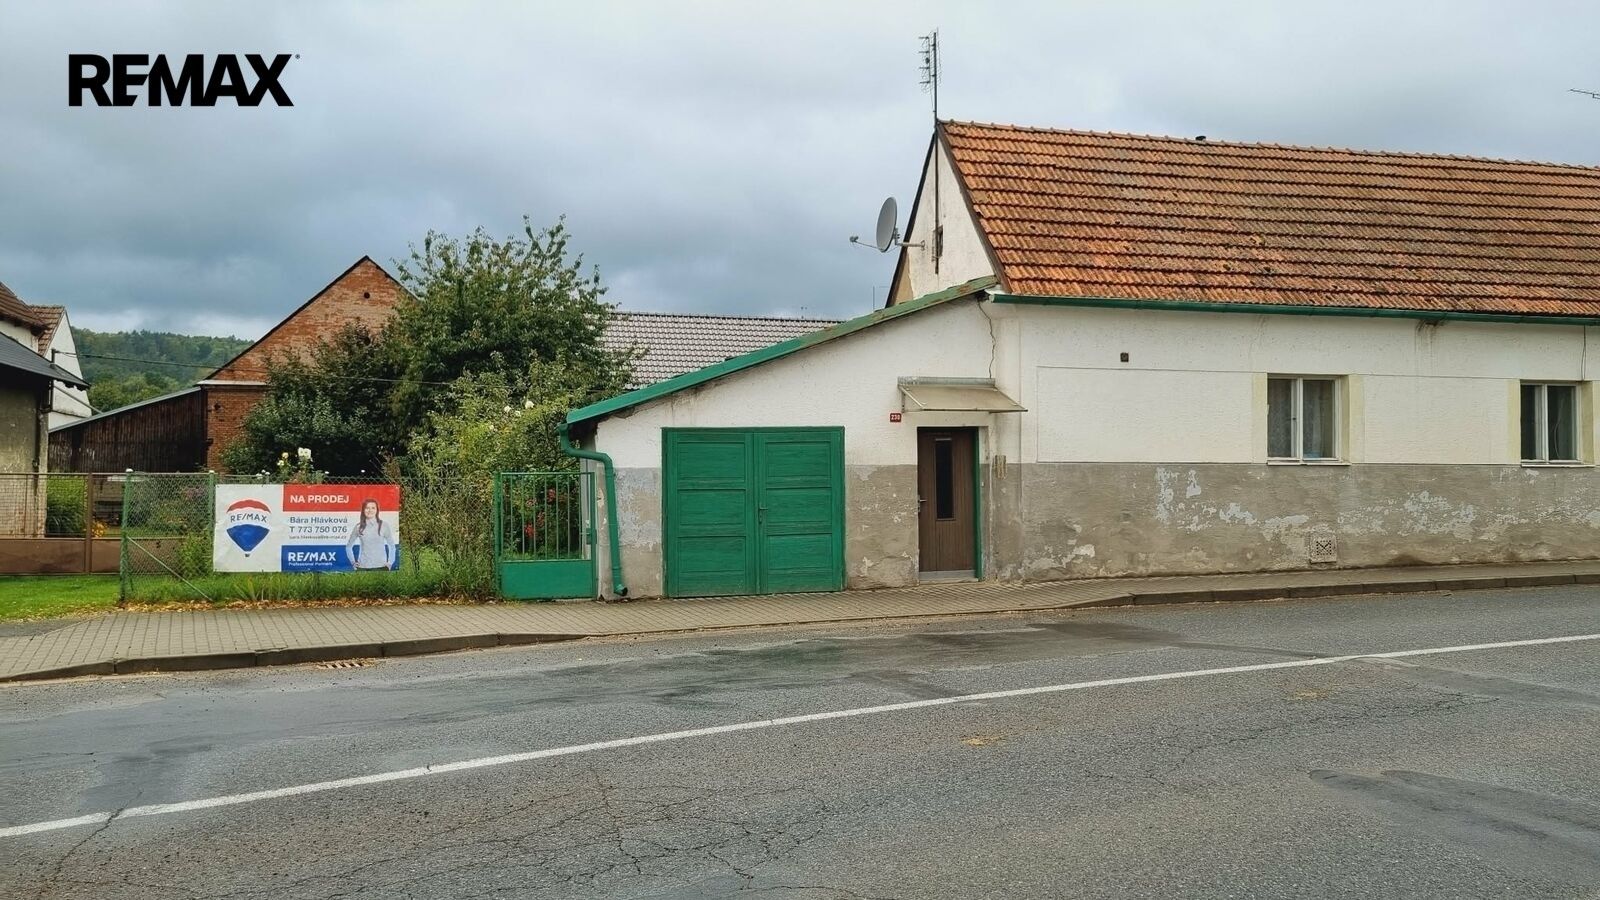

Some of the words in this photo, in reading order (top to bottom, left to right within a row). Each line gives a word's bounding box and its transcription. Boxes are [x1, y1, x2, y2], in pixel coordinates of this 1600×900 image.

[290, 494, 305, 504] NA
[308, 494, 349, 504] PRODEJ
[230, 513, 267, 523] RE/MAX
[290, 516, 309, 524] Bára
[311, 516, 348, 524] Hlávková
[288, 552, 336, 561] RE/MAX
